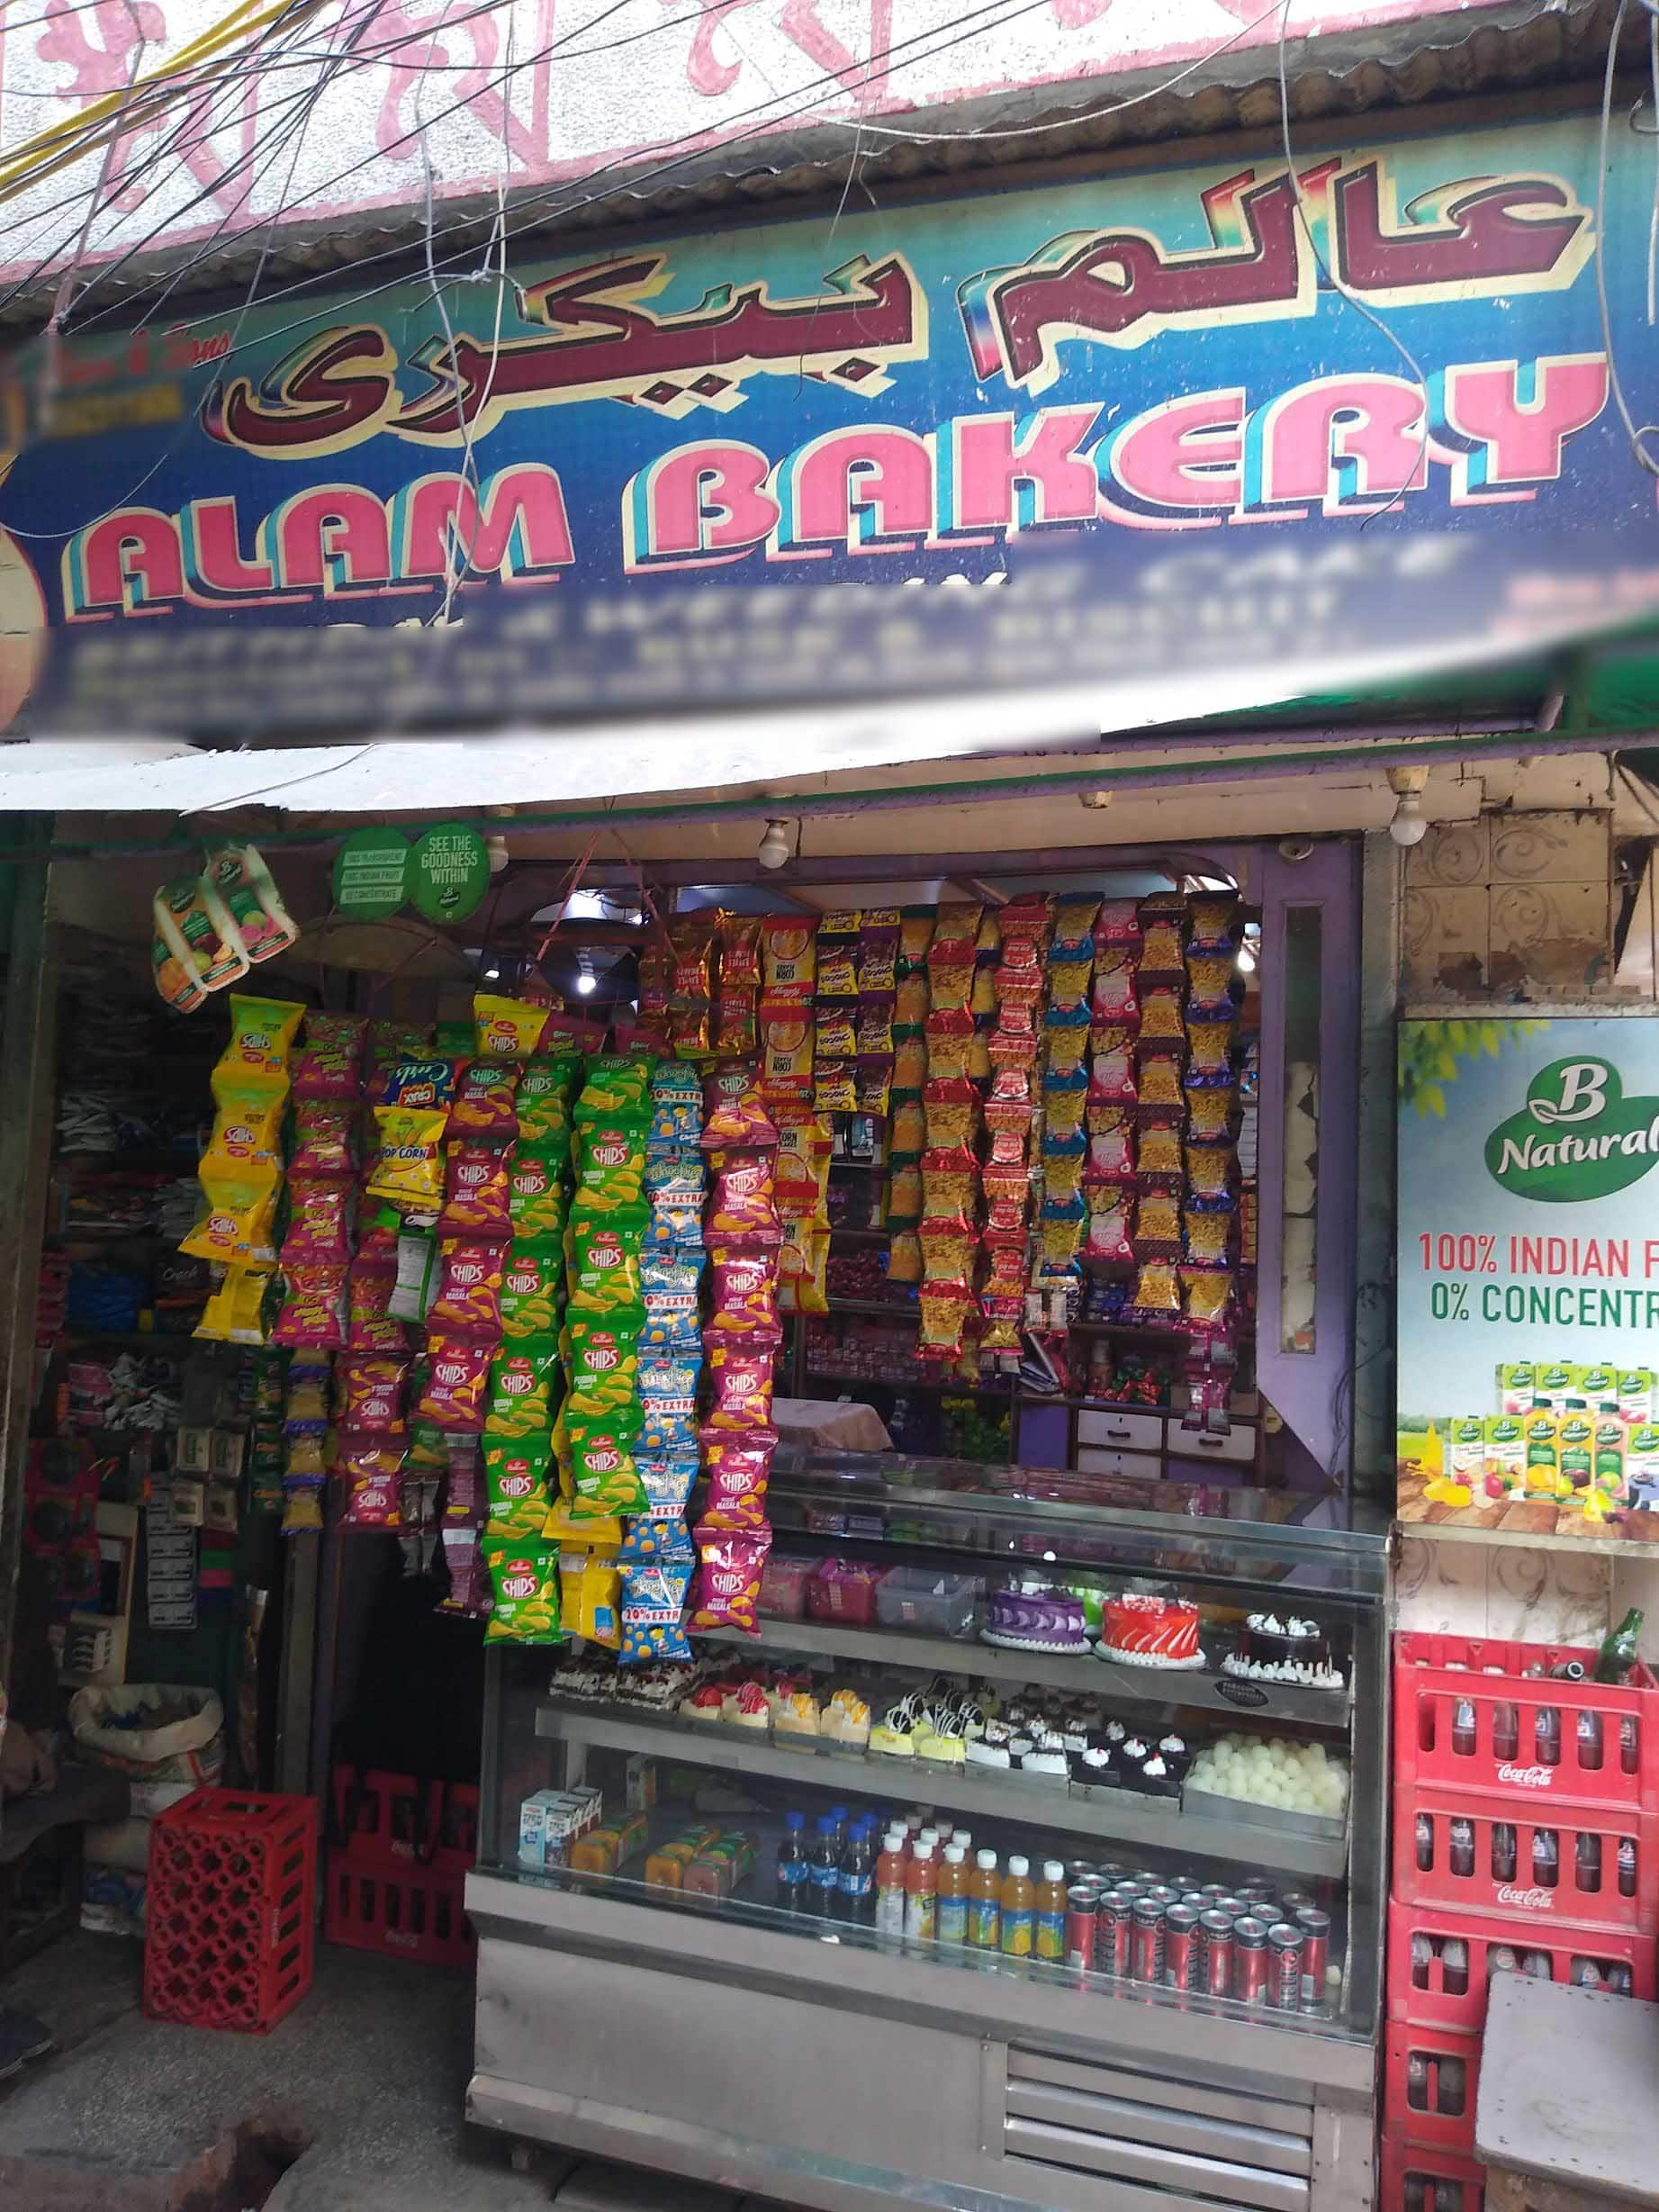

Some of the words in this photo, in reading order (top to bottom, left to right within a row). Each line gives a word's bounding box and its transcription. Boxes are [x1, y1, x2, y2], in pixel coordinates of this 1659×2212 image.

[959, 158, 1595, 393] عالم
[61, 463, 574, 623] ALAM
[623, 353, 1608, 574] BAKERY
[428, 836, 448, 851] SEE
[453, 835, 471, 851] THE
[421, 853, 477, 868] GOODNESS
[431, 868, 468, 884] WITHIN
[489, 1035, 518, 1052] CHIPS
[396, 1062, 448, 1085] Curls
[470, 1069, 502, 1084] CHIPS
[522, 1077, 555, 1094] CHIPS
[718, 1075, 750, 1094] CHIPS
[1555, 1063, 1608, 1123] B
[404, 1093, 431, 1104] CRAX
[399, 1146, 427, 1158] CORN
[1498, 1114, 1659, 1175] Natural
[593, 1145, 628, 1167] CHIPS
[458, 1165, 489, 1186] CHIPS
[513, 1175, 547, 1196] CHIPS
[726, 1173, 759, 1194] CHIPS
[588, 1247, 623, 1269] CHIPS
[1419, 1233, 1497, 1274] 100%
[1510, 1236, 1628, 1278] INDIAN
[451, 1265, 483, 1285] CHIPS
[506, 1273, 539, 1295] CHIPS
[726, 1274, 759, 1294] CHIPS
[666, 1296, 696, 1305] EXTR
[1430, 1282, 1470, 1321] 0%
[584, 1349, 619, 1371] CHIPS
[436, 1363, 468, 1386] CHIPS
[500, 1373, 535, 1395] CHIPS
[726, 1374, 757, 1395] CHIPS
[585, 1449, 620, 1473] CHIPS
[499, 1476, 533, 1497] CHIPS
[720, 1473, 753, 1494] CHIPS
[502, 1575, 537, 1599] CHIPS
[712, 1575, 744, 1596] CHIPS
[626, 1608, 650, 1620] 20%
